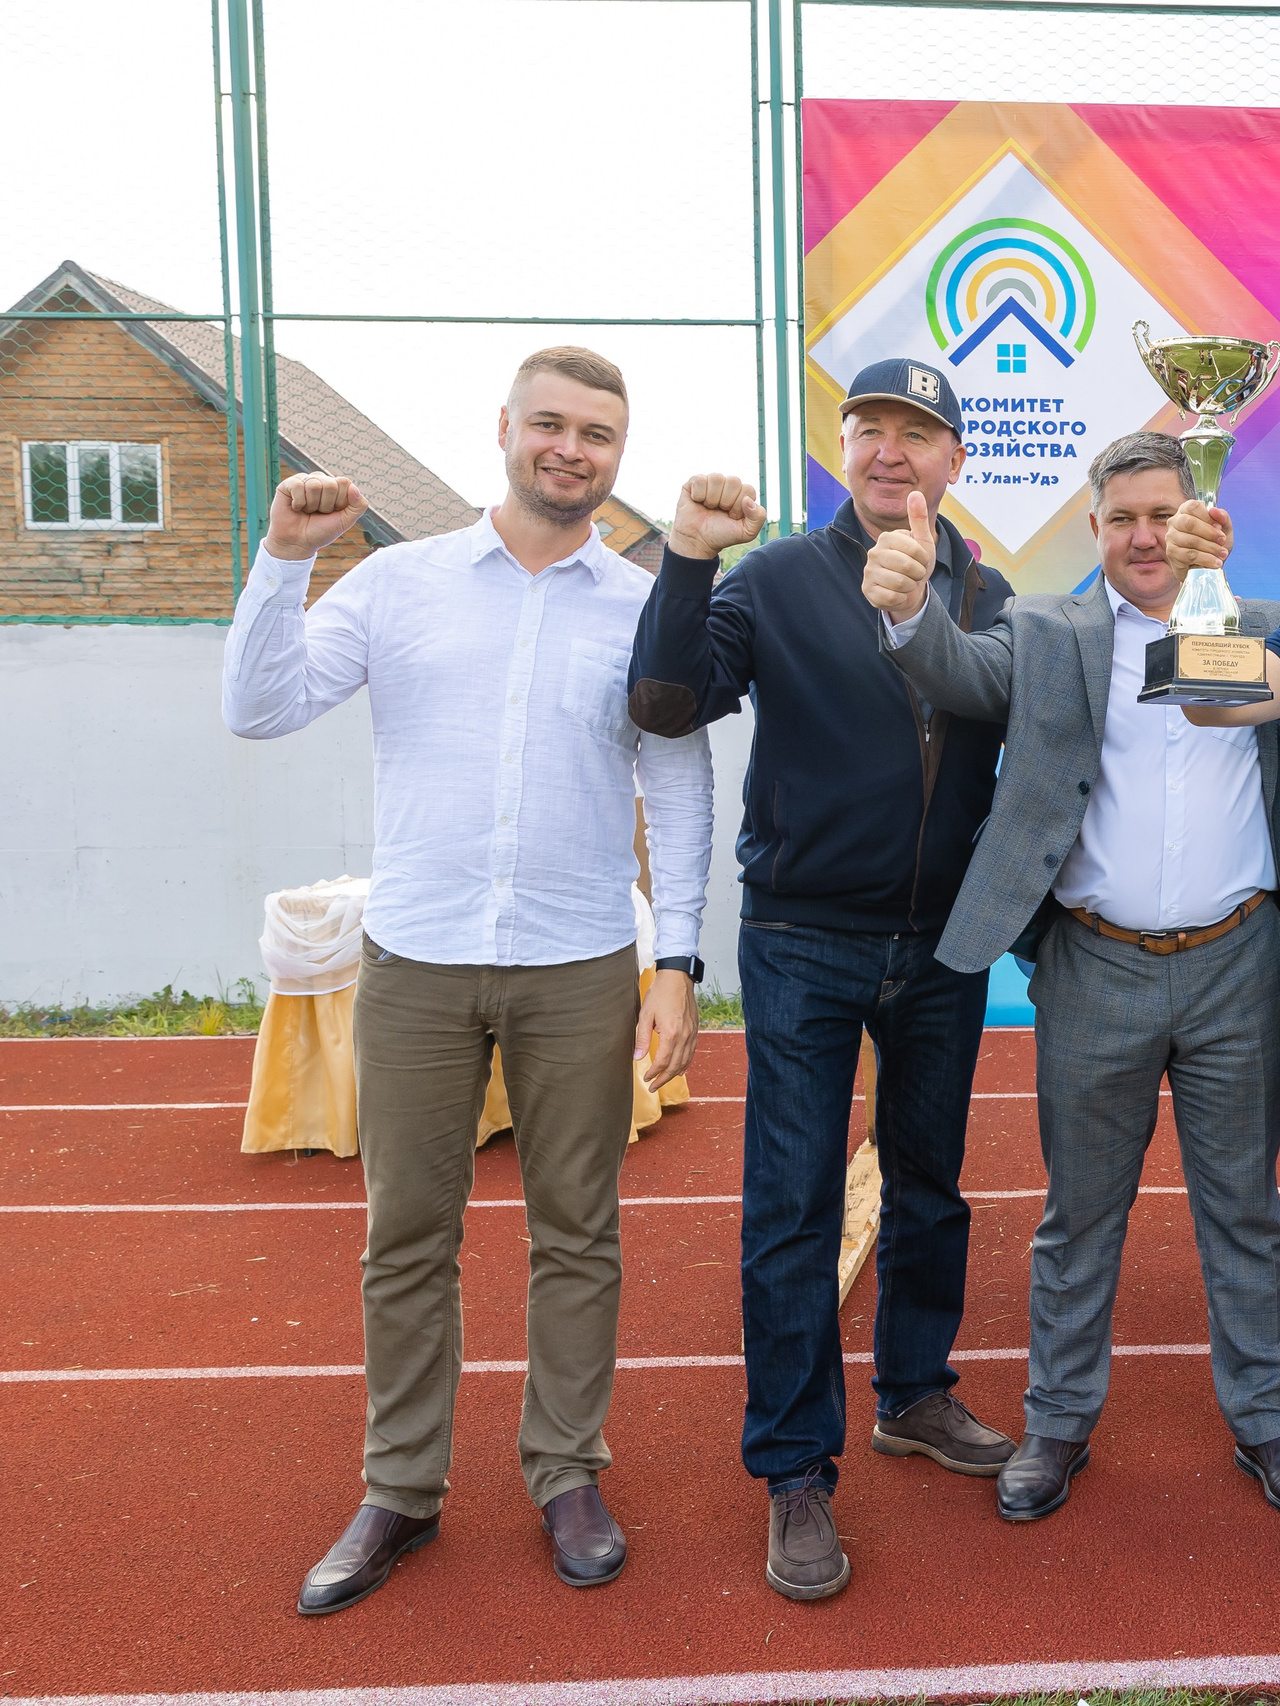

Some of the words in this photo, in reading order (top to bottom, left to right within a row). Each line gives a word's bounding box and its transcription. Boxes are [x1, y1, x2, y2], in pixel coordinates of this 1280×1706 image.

[907, 365, 941, 404] B
[961, 397, 1064, 413] КОМИТЕТ
[961, 420, 1087, 437] РОДСКОГО
[965, 439, 1077, 458] ОЗЯЙСТВА
[966, 474, 978, 484] г.
[982, 472, 1059, 486] Улан-Удэ
